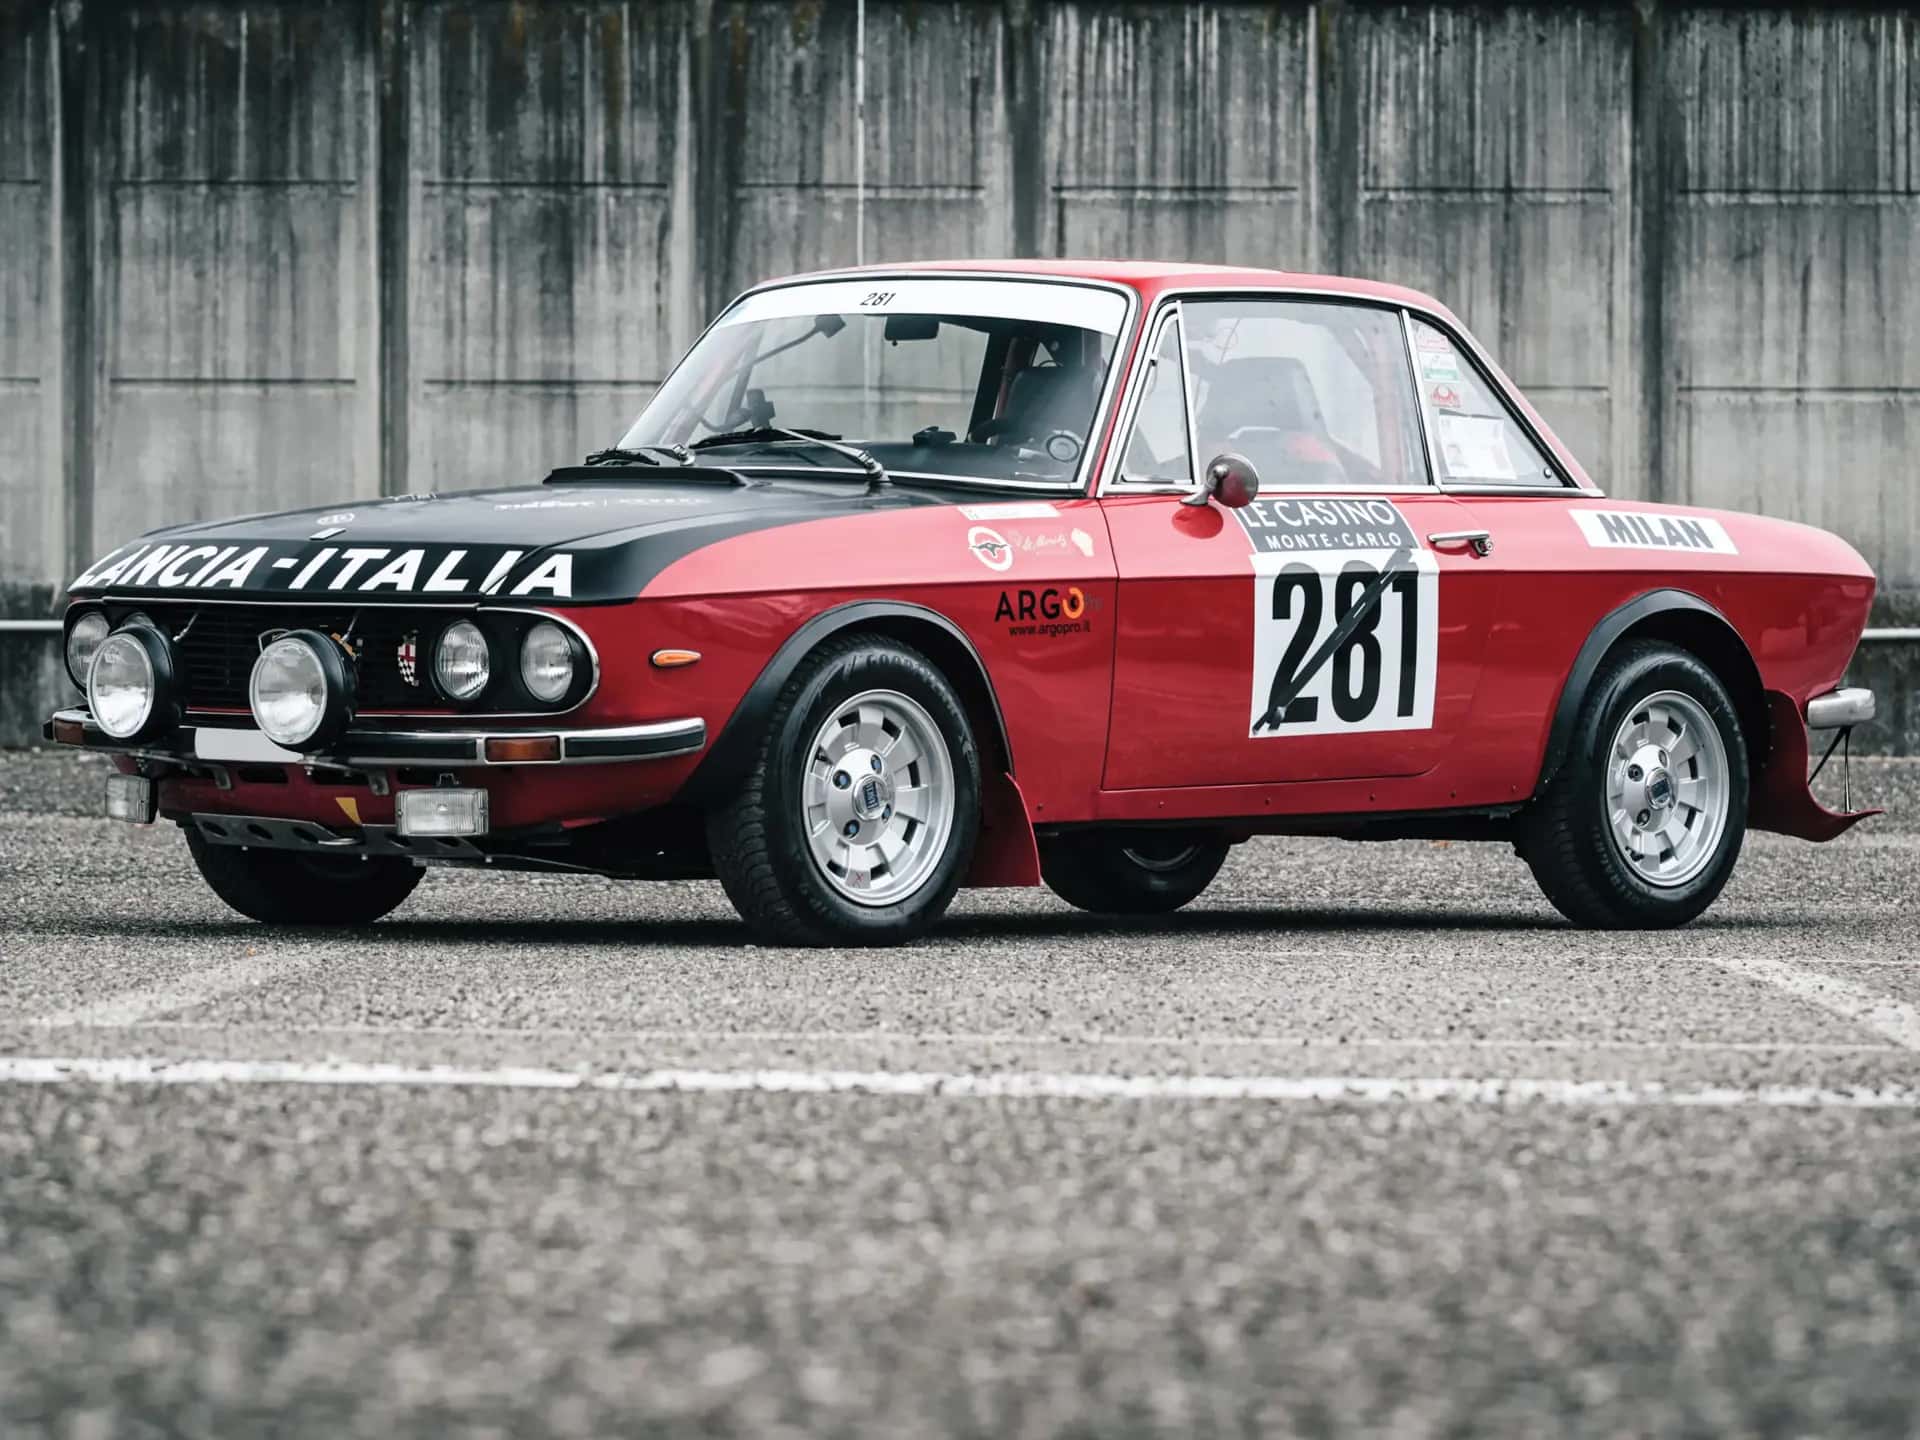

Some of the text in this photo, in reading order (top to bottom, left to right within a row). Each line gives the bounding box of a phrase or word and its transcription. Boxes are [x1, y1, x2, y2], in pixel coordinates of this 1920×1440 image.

[859, 292, 897, 306] 281
[1273, 500, 1396, 528] CASINO
[1596, 513, 1714, 549] MILAN
[1266, 560, 1419, 724] 281
